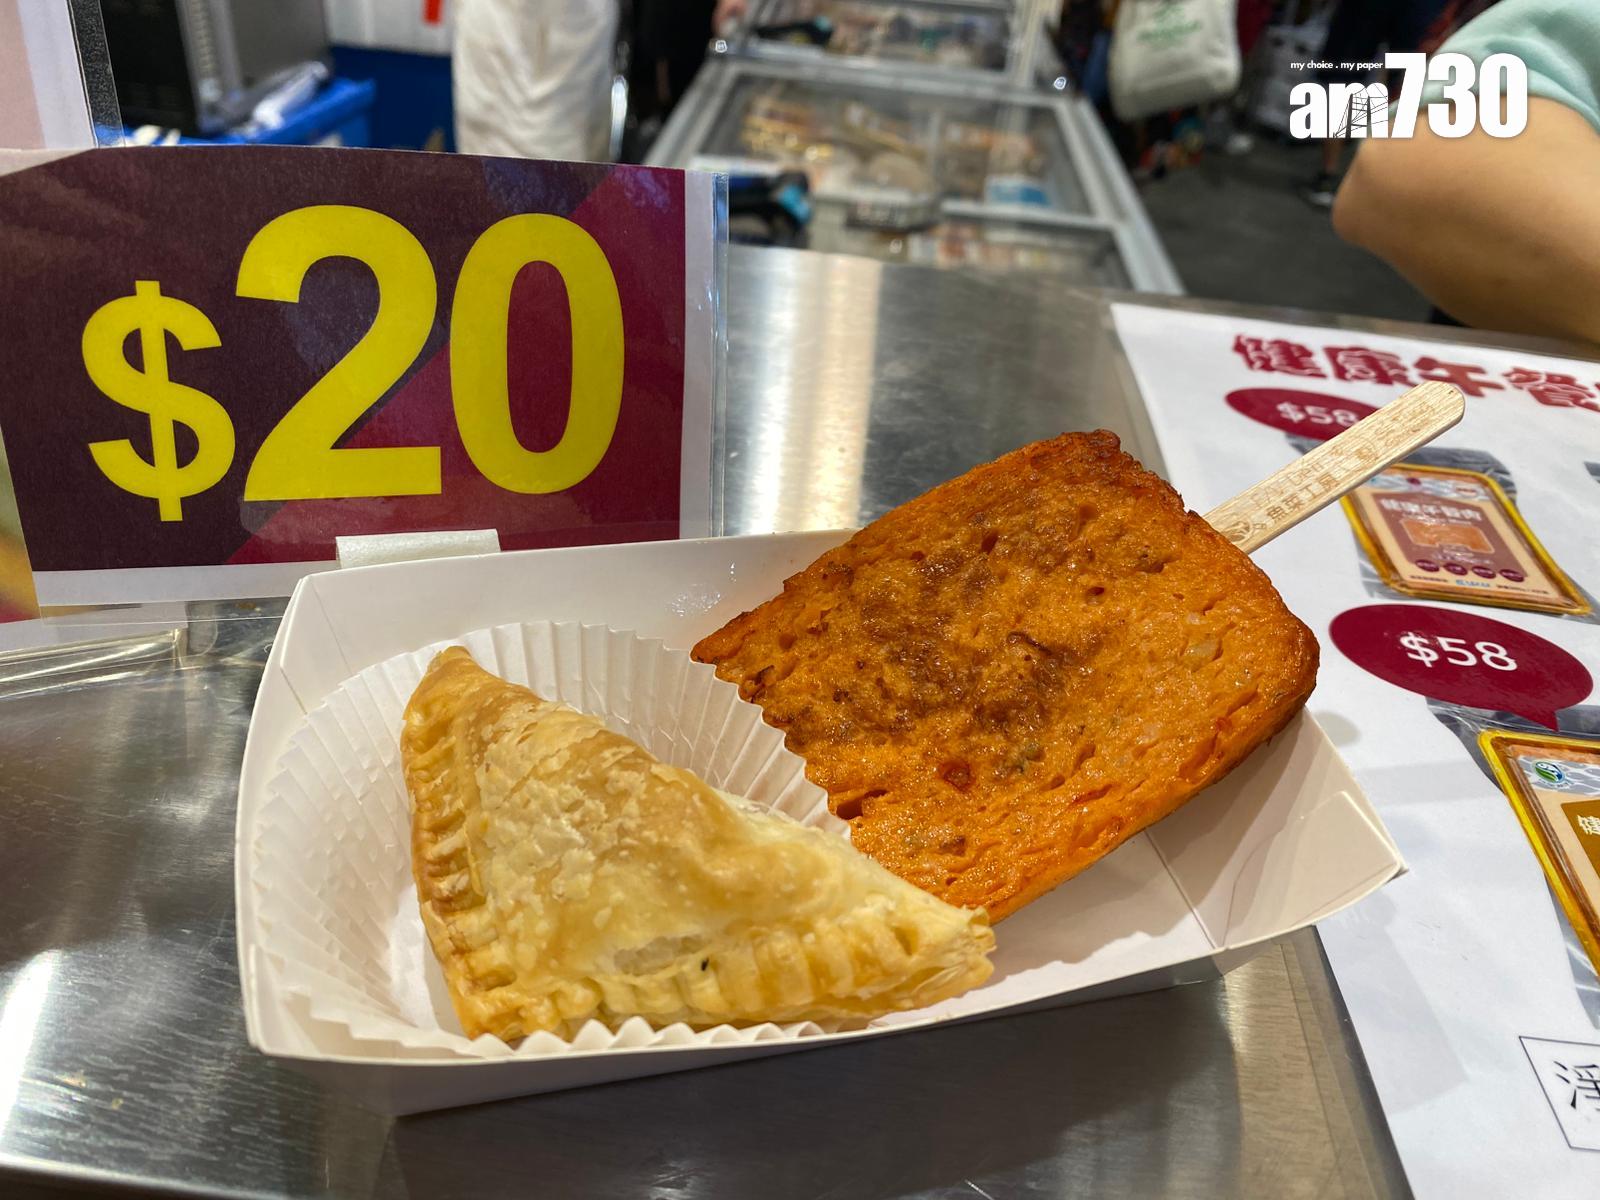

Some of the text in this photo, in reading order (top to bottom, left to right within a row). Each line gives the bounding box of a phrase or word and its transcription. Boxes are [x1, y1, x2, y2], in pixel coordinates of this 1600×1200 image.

[82, 205, 625, 521] $20
[1233, 334, 1600, 413] 健康午餐
[1400, 631, 1518, 671] $58
